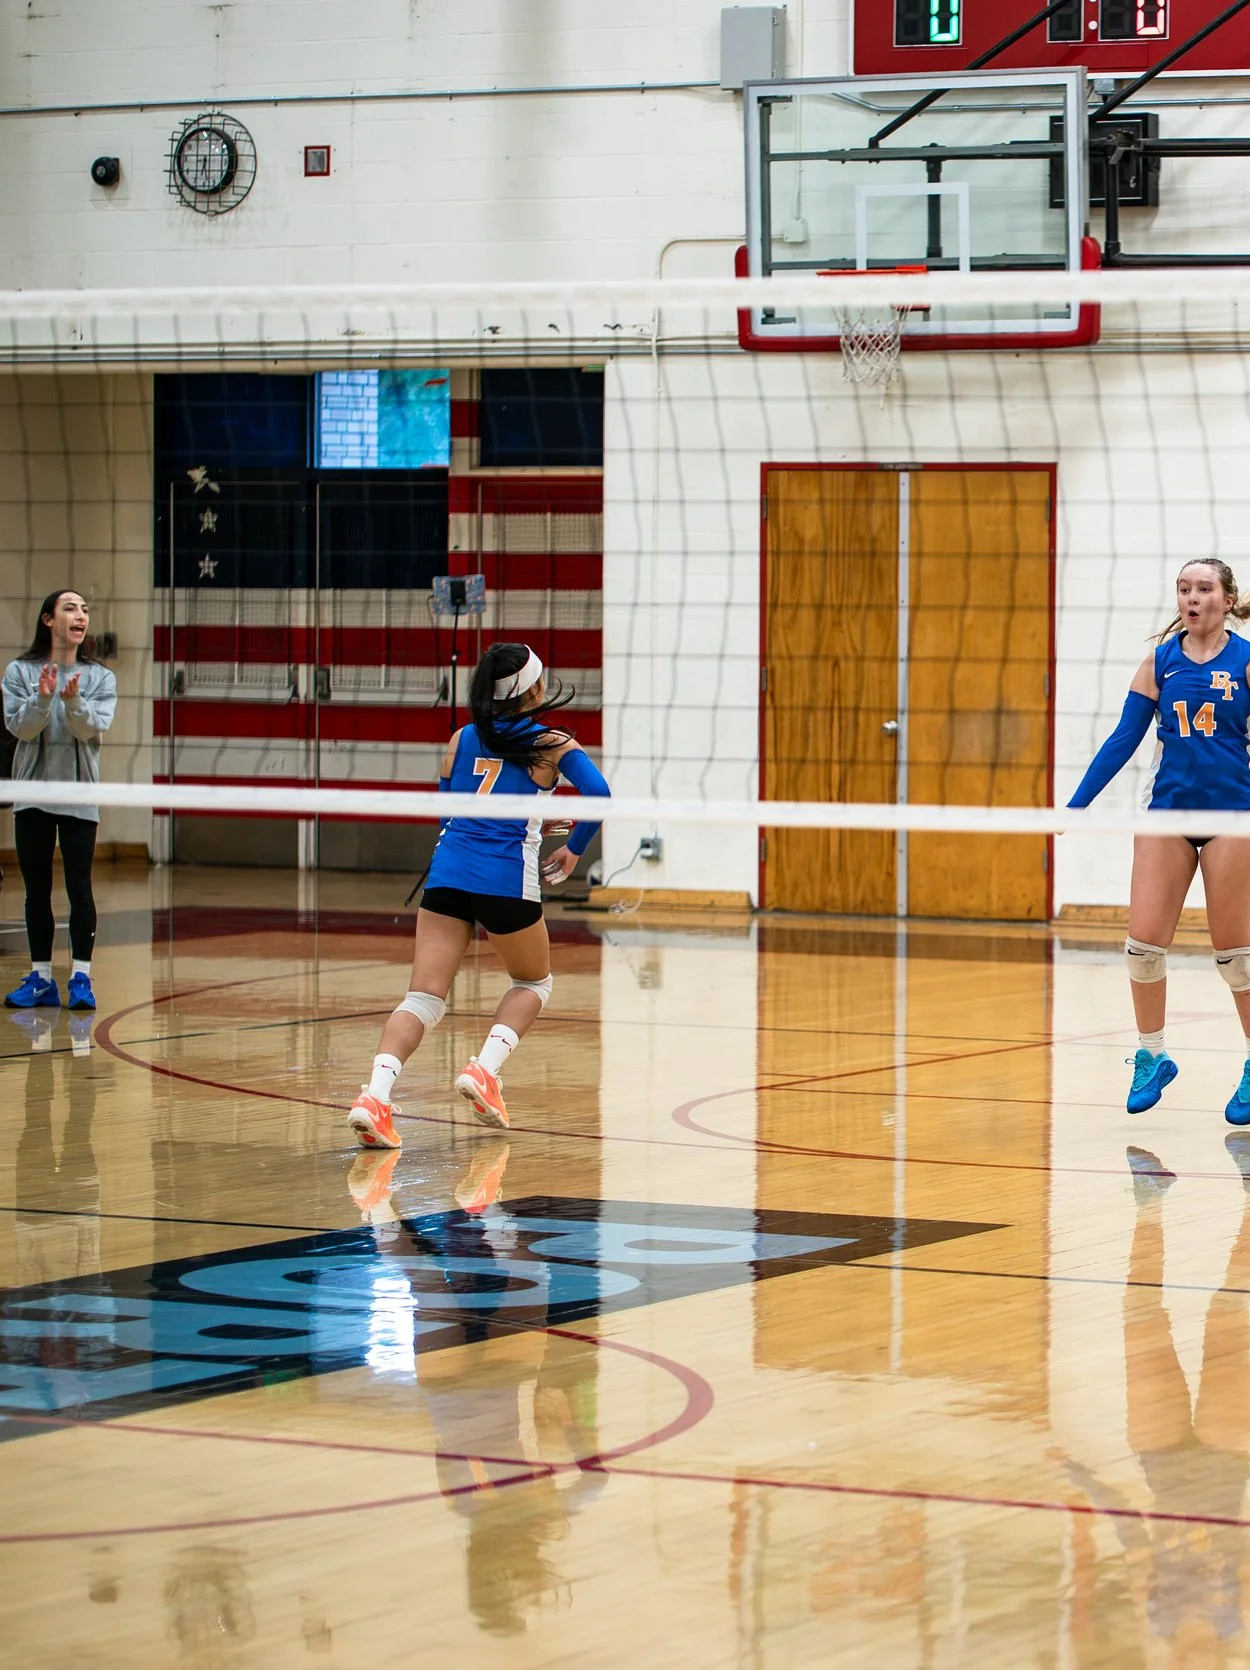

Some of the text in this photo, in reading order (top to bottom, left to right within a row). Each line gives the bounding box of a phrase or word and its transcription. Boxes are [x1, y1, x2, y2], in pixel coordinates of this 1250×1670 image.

[1210, 671, 1239, 701] BT
[1172, 700, 1217, 738] 14
[473, 757, 504, 796] 7
